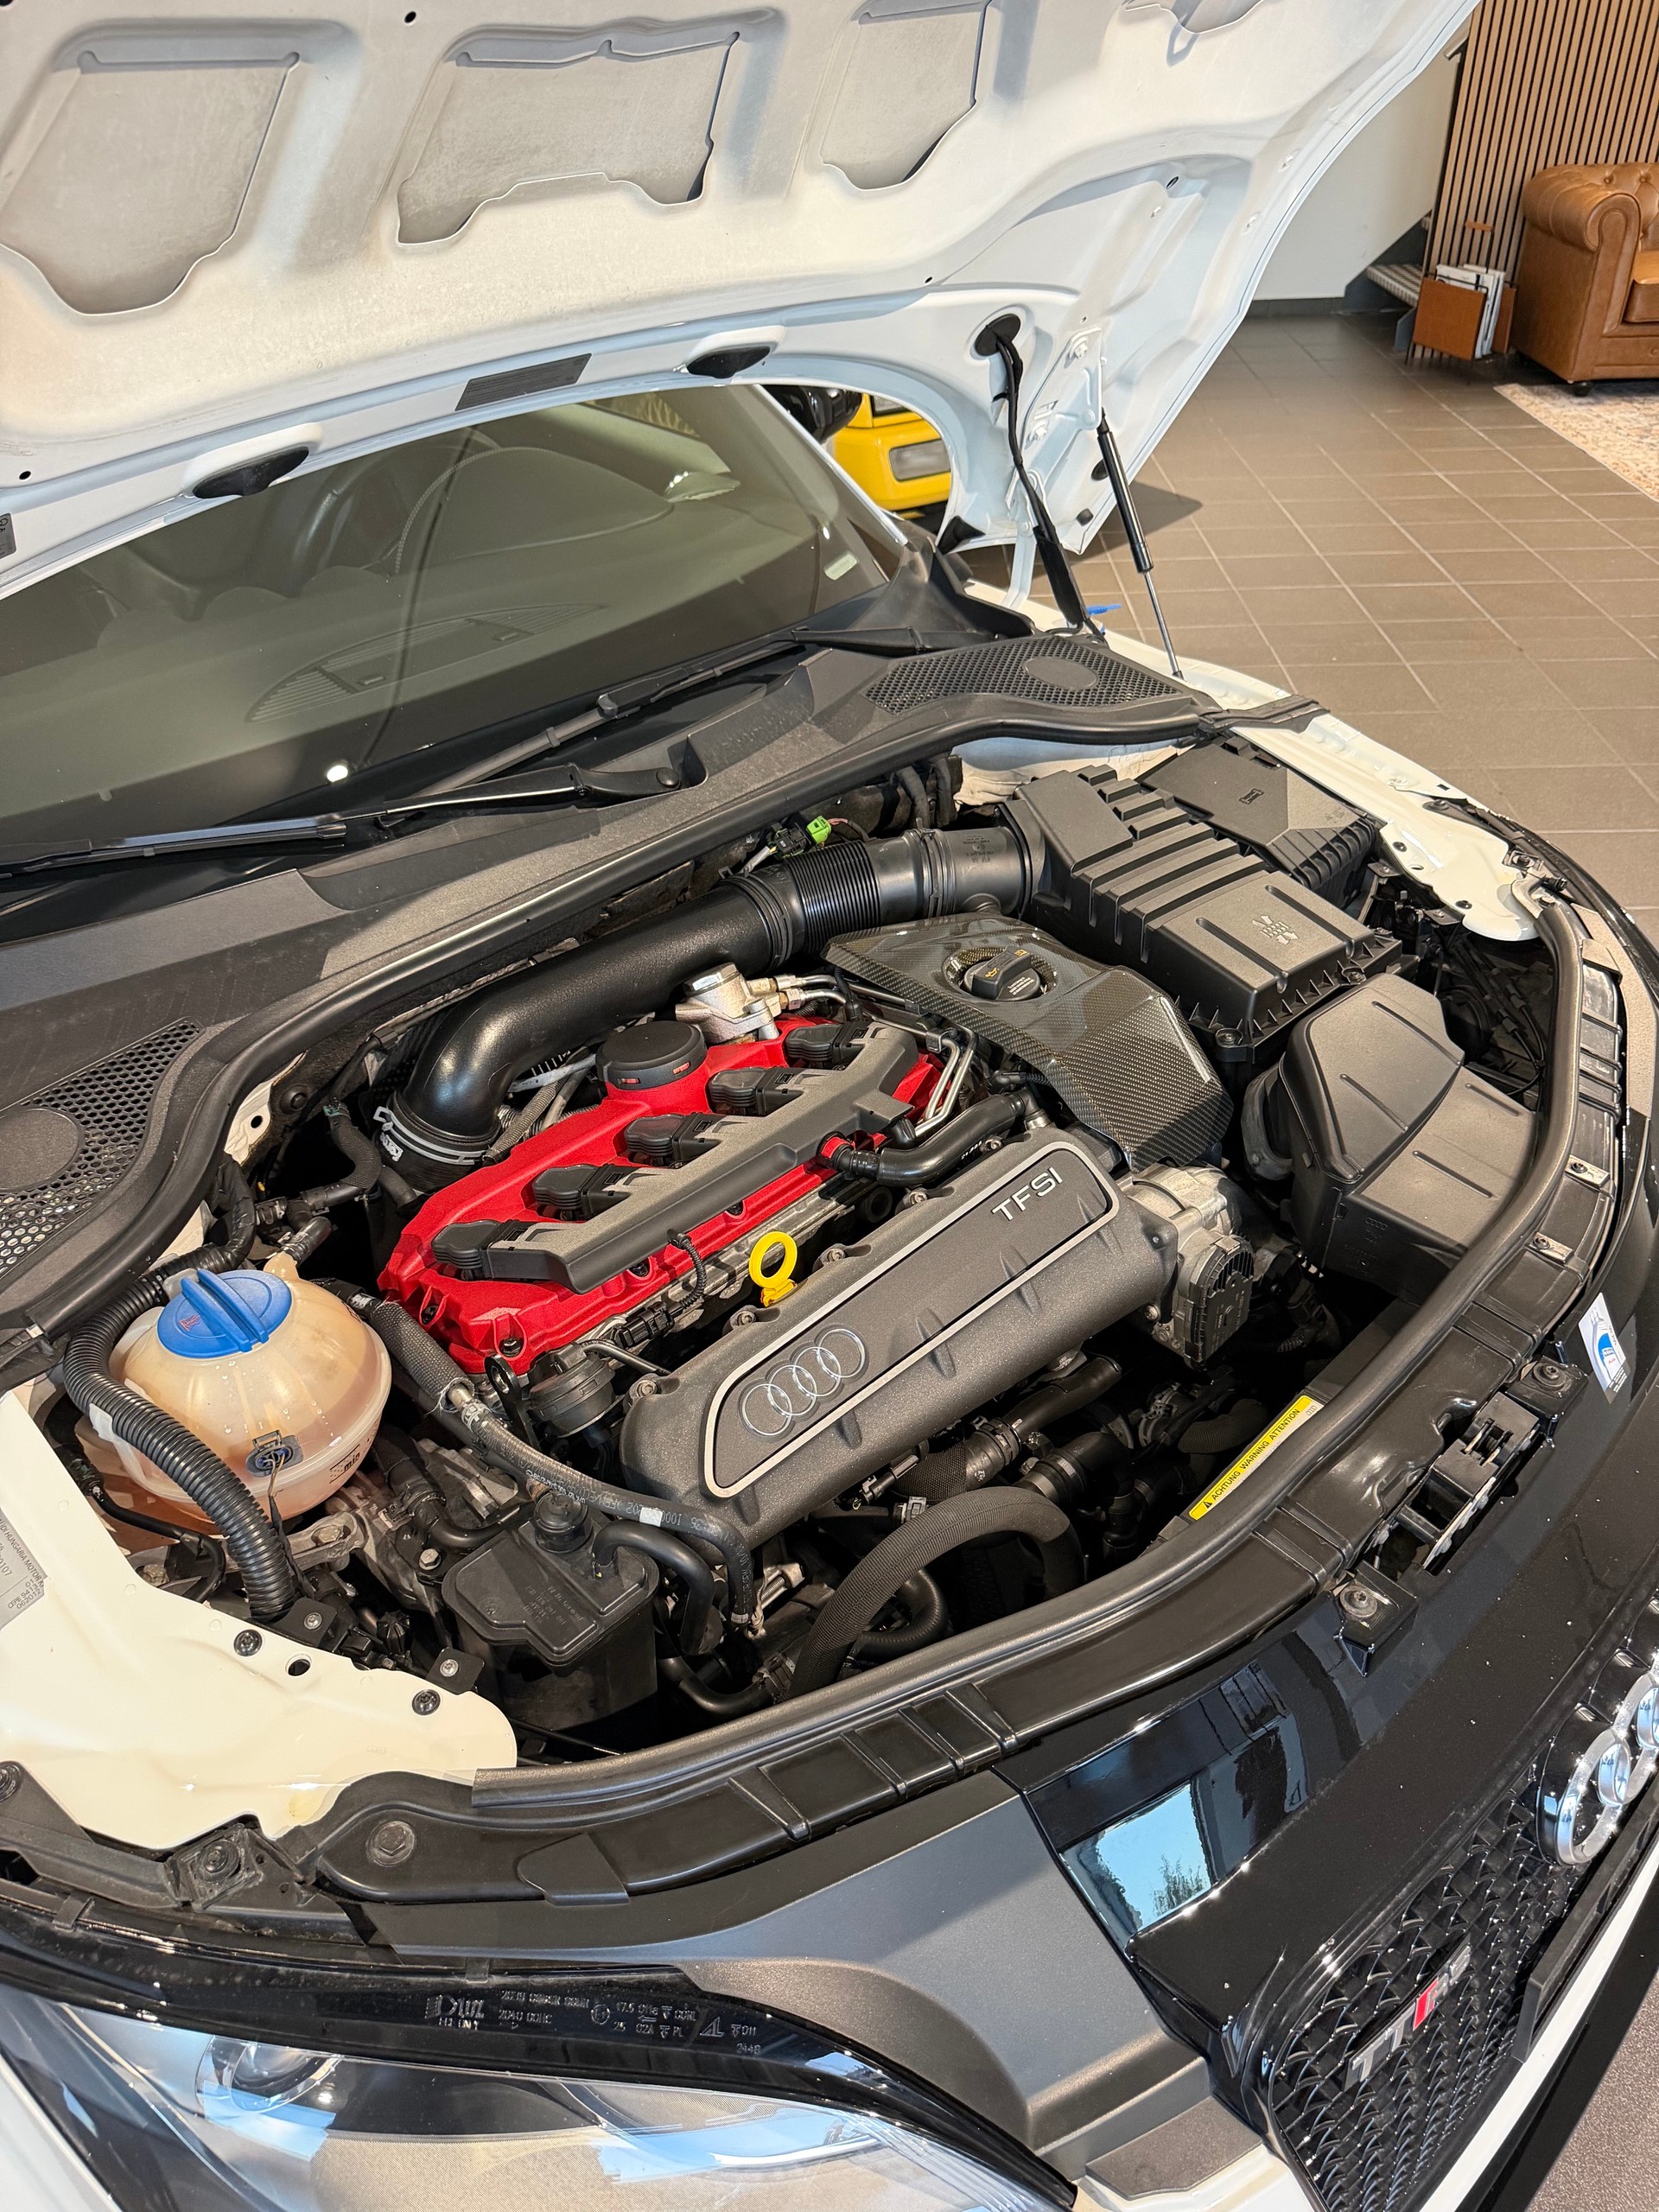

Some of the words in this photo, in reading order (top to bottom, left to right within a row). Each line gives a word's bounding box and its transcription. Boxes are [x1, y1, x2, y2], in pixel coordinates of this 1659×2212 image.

[991, 1166, 1063, 1221] TFSI
[345, 1452, 360, 1471] min
[1211, 1471, 1241, 1500] ACHTUNG
[1239, 1440, 1269, 1470] WARNING
[1268, 1408, 1300, 1440] ATTENTION
[4, 1531, 28, 1561] HUNGARIA
[23, 1560, 42, 1584] MOTOR
[16, 1587, 41, 1610] 062012
[21, 1583, 38, 1598] 9413
[1352, 2001, 1416, 2082] TT
